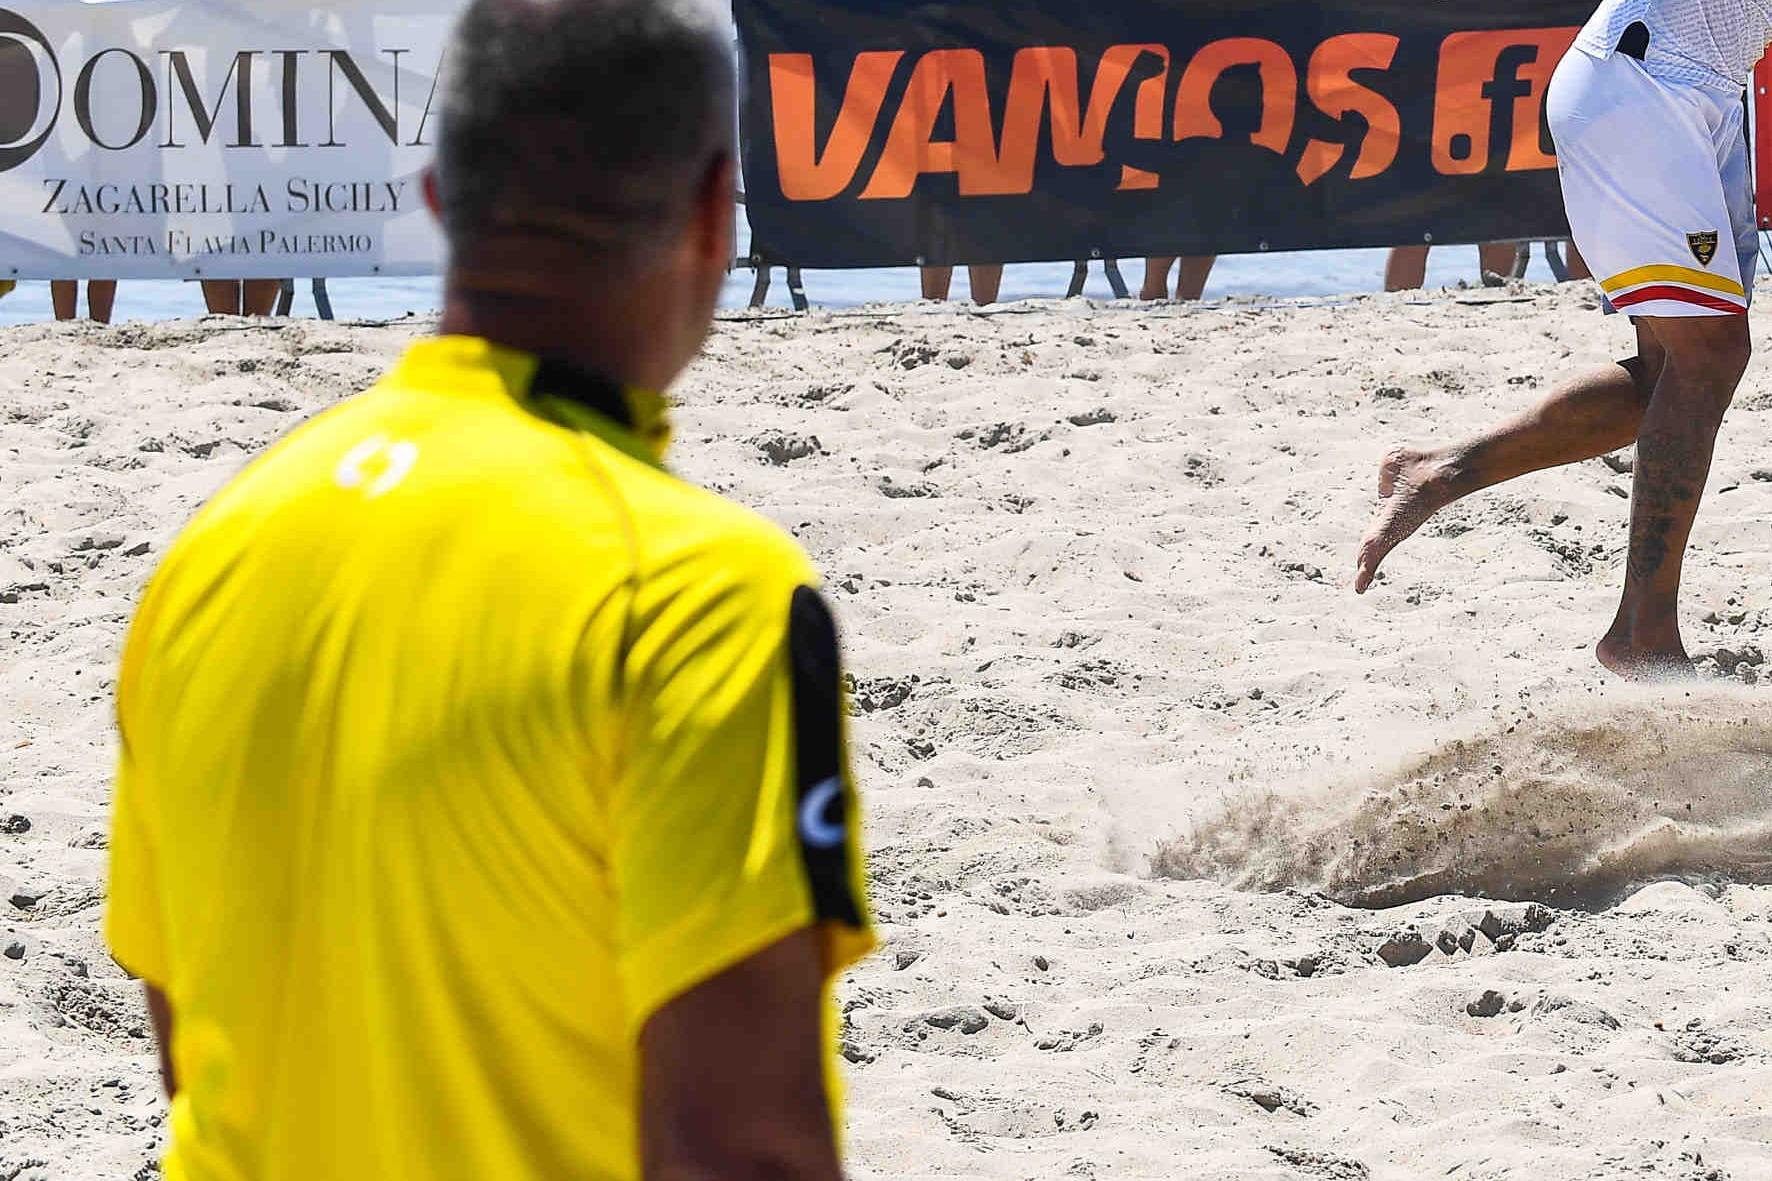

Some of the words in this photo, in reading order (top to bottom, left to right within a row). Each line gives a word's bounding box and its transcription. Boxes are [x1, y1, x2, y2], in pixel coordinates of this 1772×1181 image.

[0, 6, 446, 173] OMIN
[768, 32, 1401, 201] VAMOS
[41, 178, 271, 214] ZAGARELLA
[286, 176, 405, 213] SICILY
[80, 229, 157, 256] SANTA
[167, 229, 252, 256] FLAVIA
[259, 228, 373, 254] PALERMO
